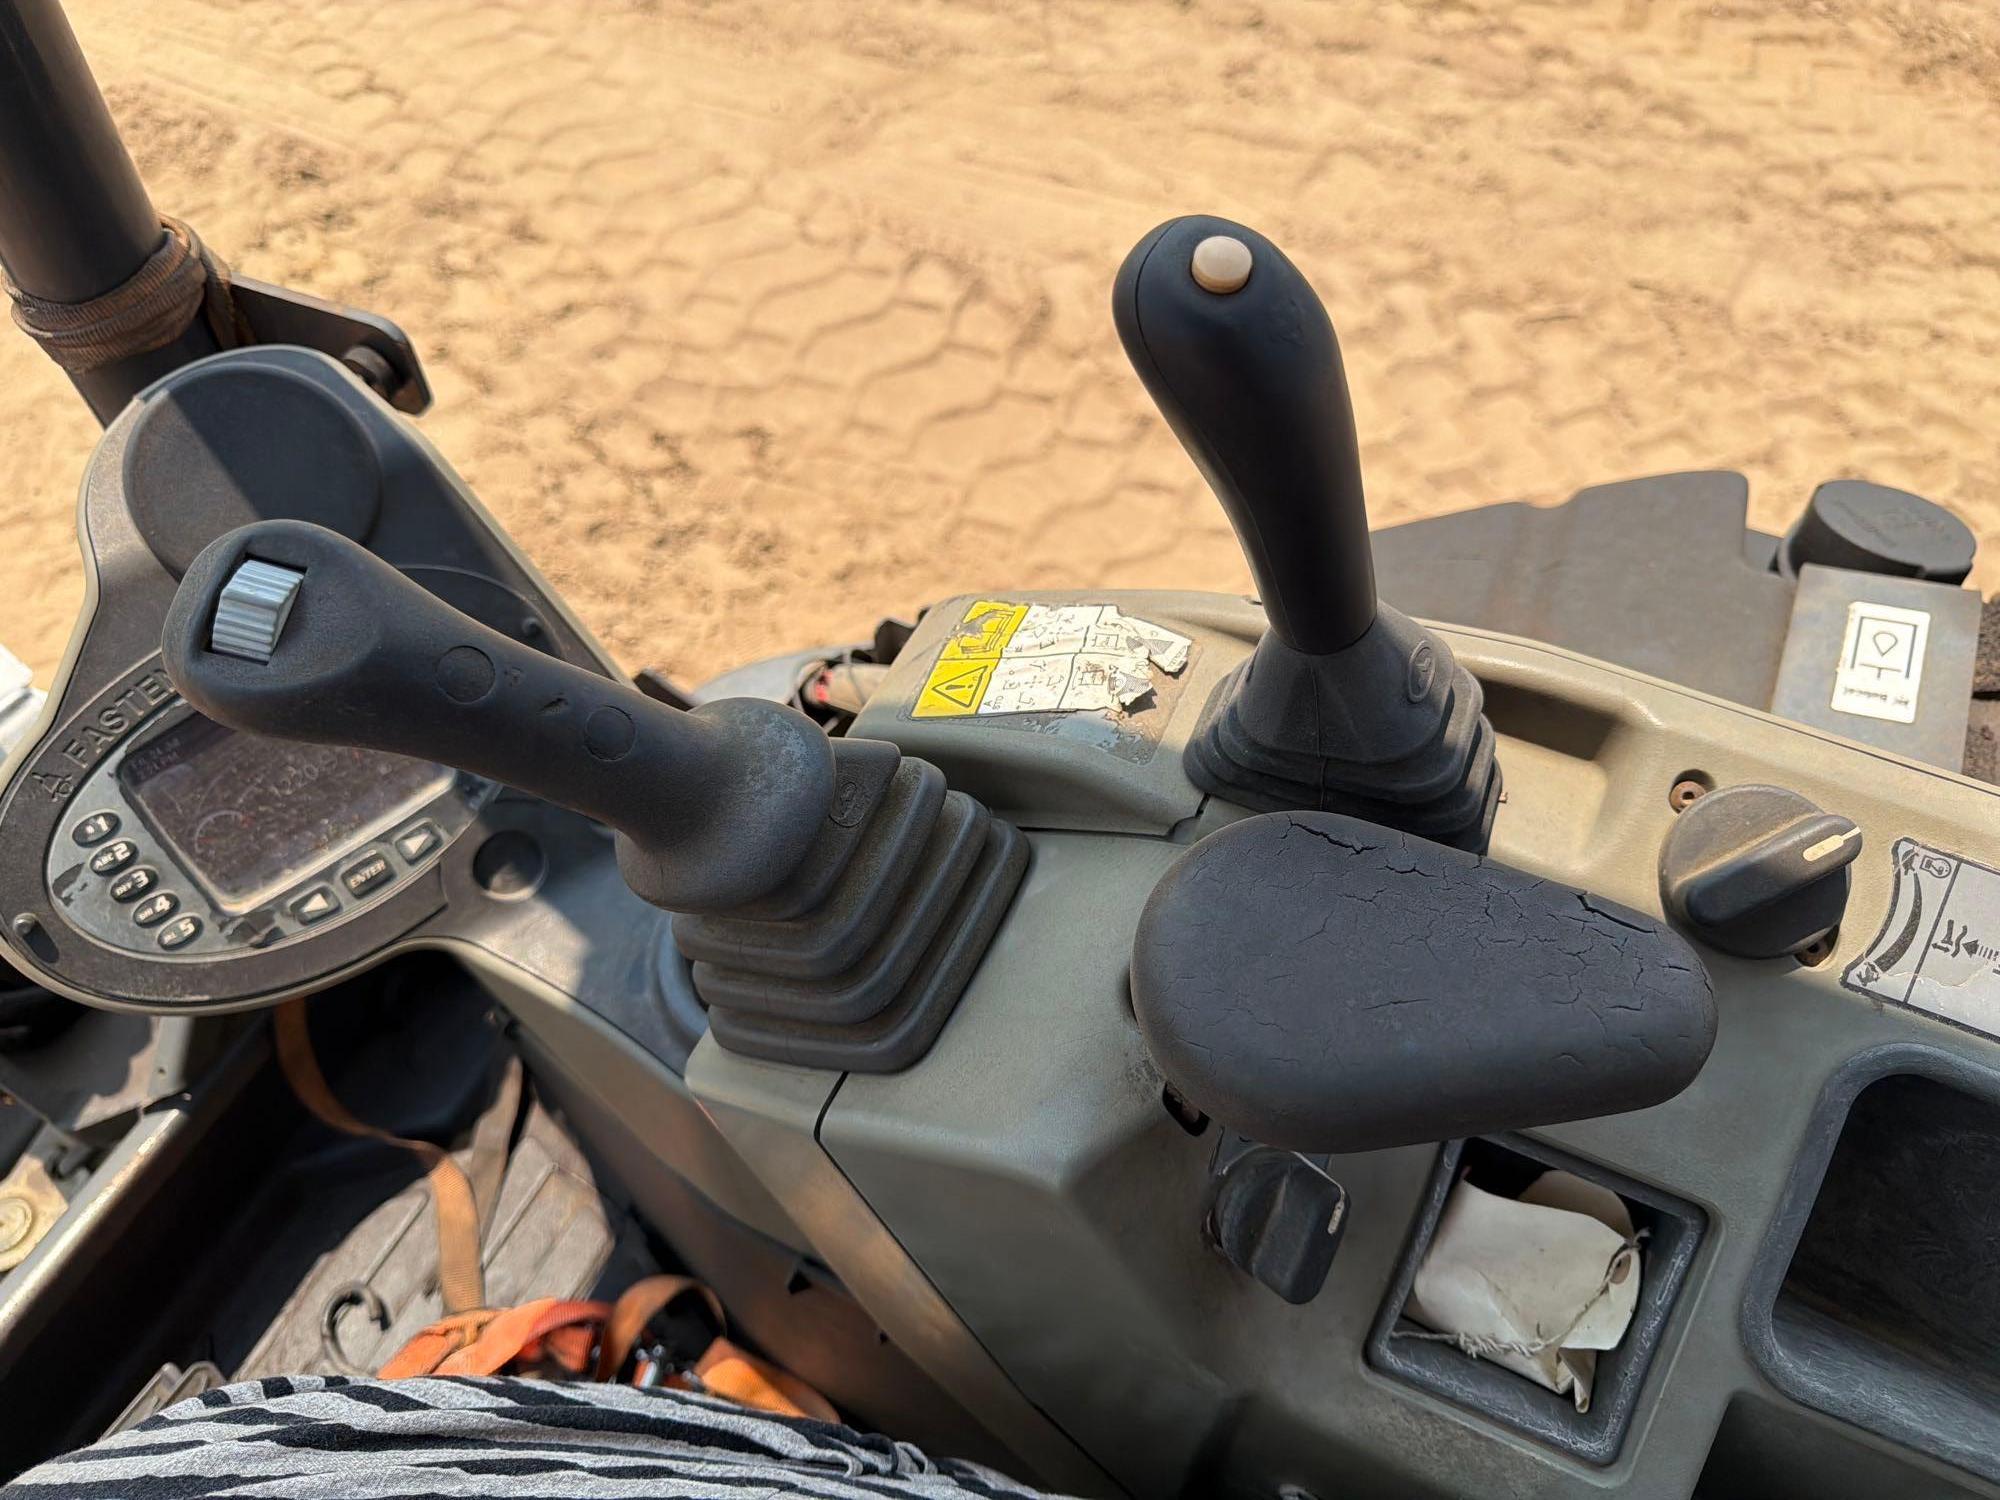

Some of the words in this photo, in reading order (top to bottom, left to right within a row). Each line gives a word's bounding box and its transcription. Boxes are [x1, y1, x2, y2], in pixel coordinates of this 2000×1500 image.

[97, 816, 109, 832] 1
[112, 842, 131, 861] 2
[131, 870, 149, 889] 3
[350, 858, 386, 889] ENTER
[154, 895, 171, 913] 4
[179, 918, 195, 936] 5
